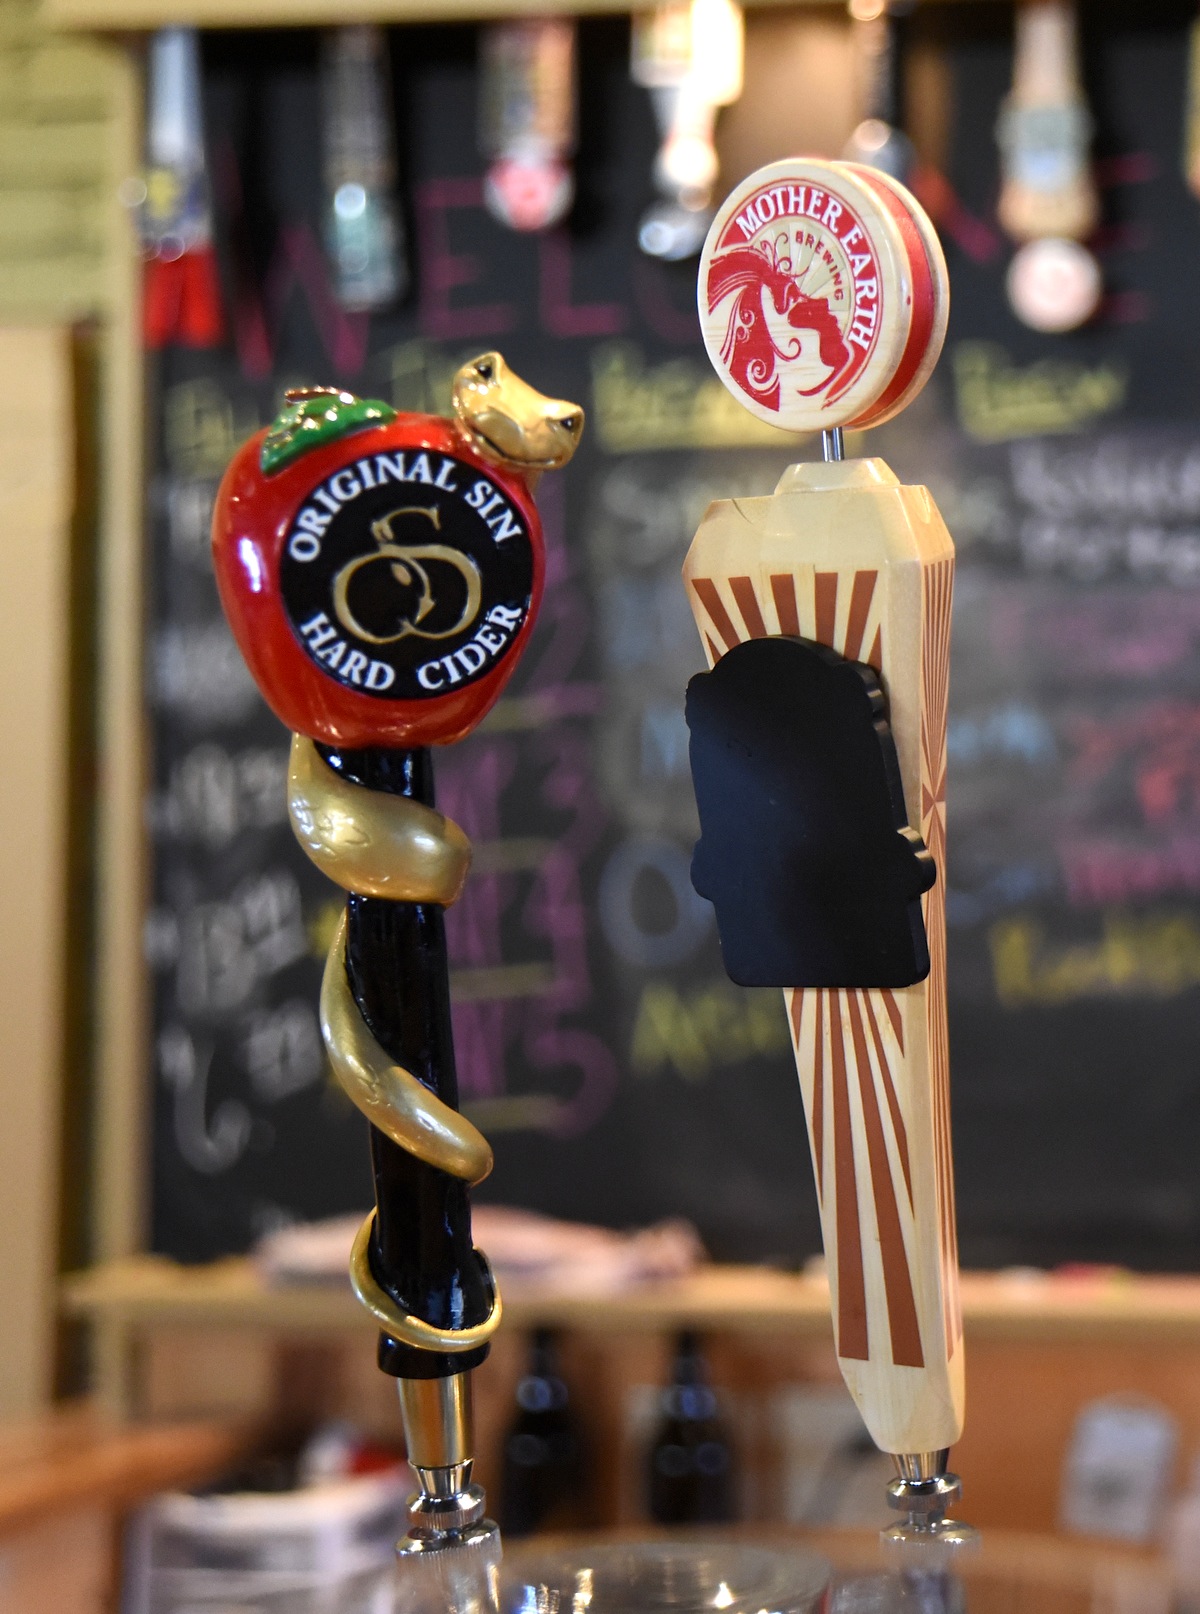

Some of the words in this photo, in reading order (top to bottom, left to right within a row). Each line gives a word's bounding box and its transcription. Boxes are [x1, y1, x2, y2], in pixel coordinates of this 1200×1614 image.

[735, 186, 843, 241] MOTHER
[840, 231, 879, 351] EARTH
[796, 230, 844, 302] BREWING
[288, 452, 458, 563] ORIGINAL
[464, 480, 523, 543] SIN
[301, 612, 396, 691] HARD
[416, 604, 523, 691] CIDER
